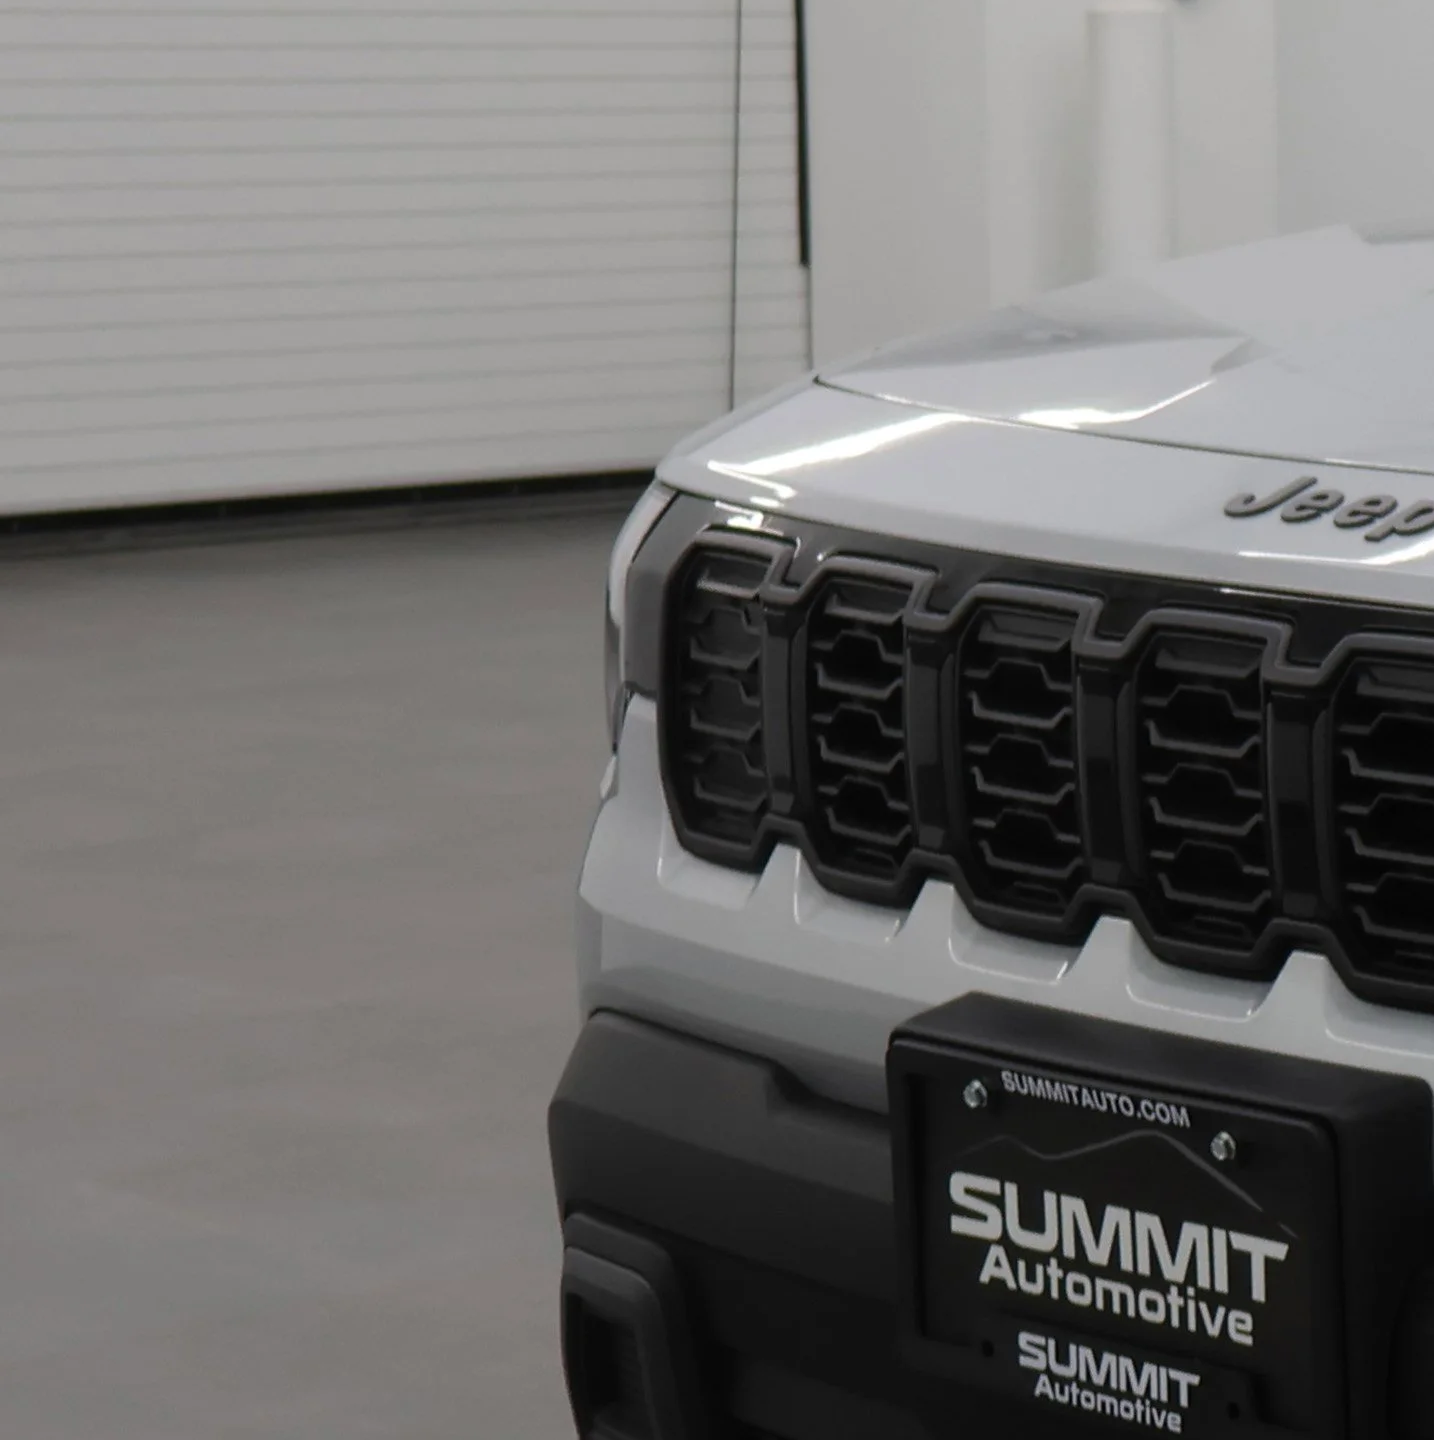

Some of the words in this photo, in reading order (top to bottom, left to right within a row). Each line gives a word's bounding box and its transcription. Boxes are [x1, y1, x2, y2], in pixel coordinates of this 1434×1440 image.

[1001, 1070, 1190, 1128] SUMMITAUTO.COM
[949, 1171, 1289, 1303] SUMMIT
[979, 1245, 1253, 1346] Automotive
[1018, 1332, 1200, 1408] SUMMIT
[1034, 1373, 1182, 1433] Automotive
